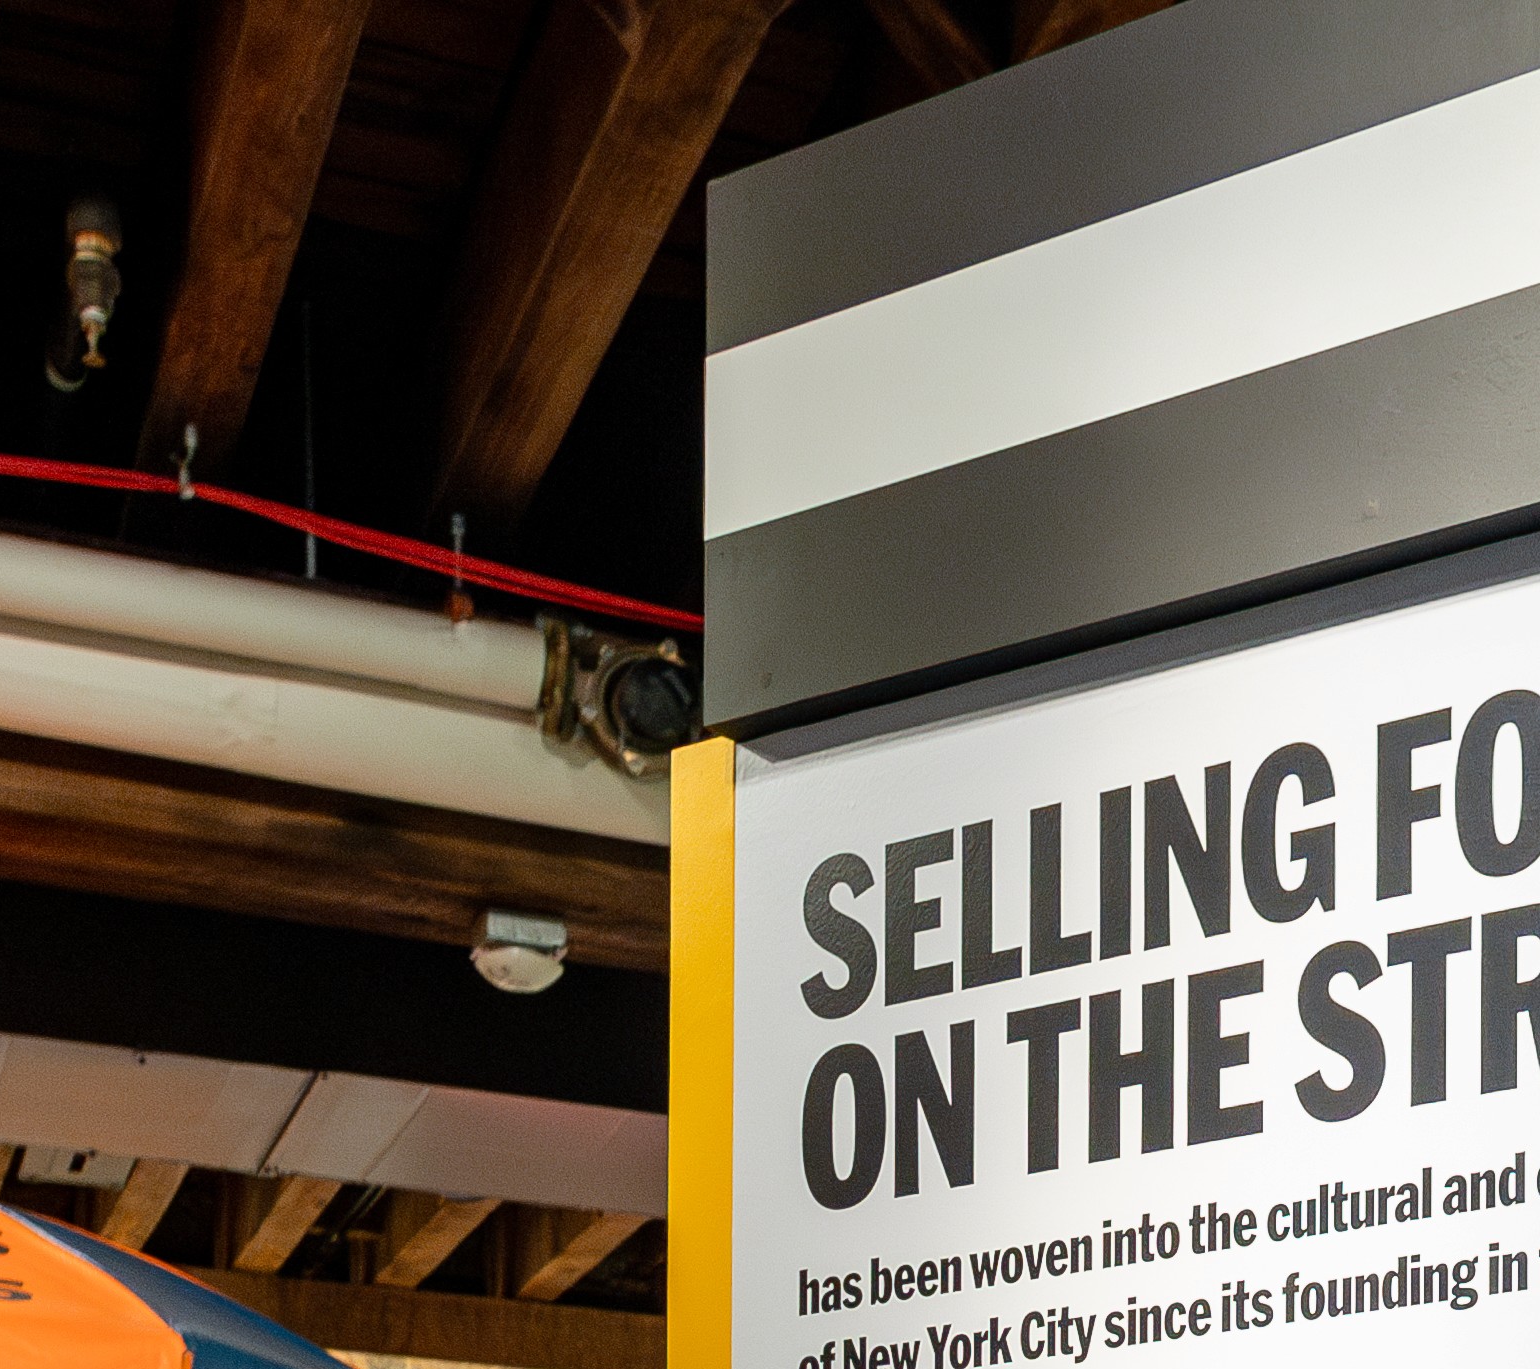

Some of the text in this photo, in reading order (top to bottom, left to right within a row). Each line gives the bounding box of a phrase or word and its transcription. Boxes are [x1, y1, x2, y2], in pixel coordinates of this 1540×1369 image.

[800, 742, 1336, 1020] SELLING
[801, 1019, 975, 1211] ON
[1006, 960, 1264, 1175] THE
[798, 1269, 863, 1317] has
[870, 1256, 962, 1306] been
[969, 1235, 1093, 1289] woven
[1102, 1213, 1180, 1269] into
[1188, 1202, 1258, 1255] the
[1267, 1166, 1432, 1242] cultural
[1442, 1151, 1526, 1216] and
[1020, 1306, 1097, 1364] City
[1104, 1296, 1212, 1349] since
[1221, 1280, 1274, 1333] its
[1282, 1254, 1479, 1324] founding
[1488, 1242, 1528, 1295] in
